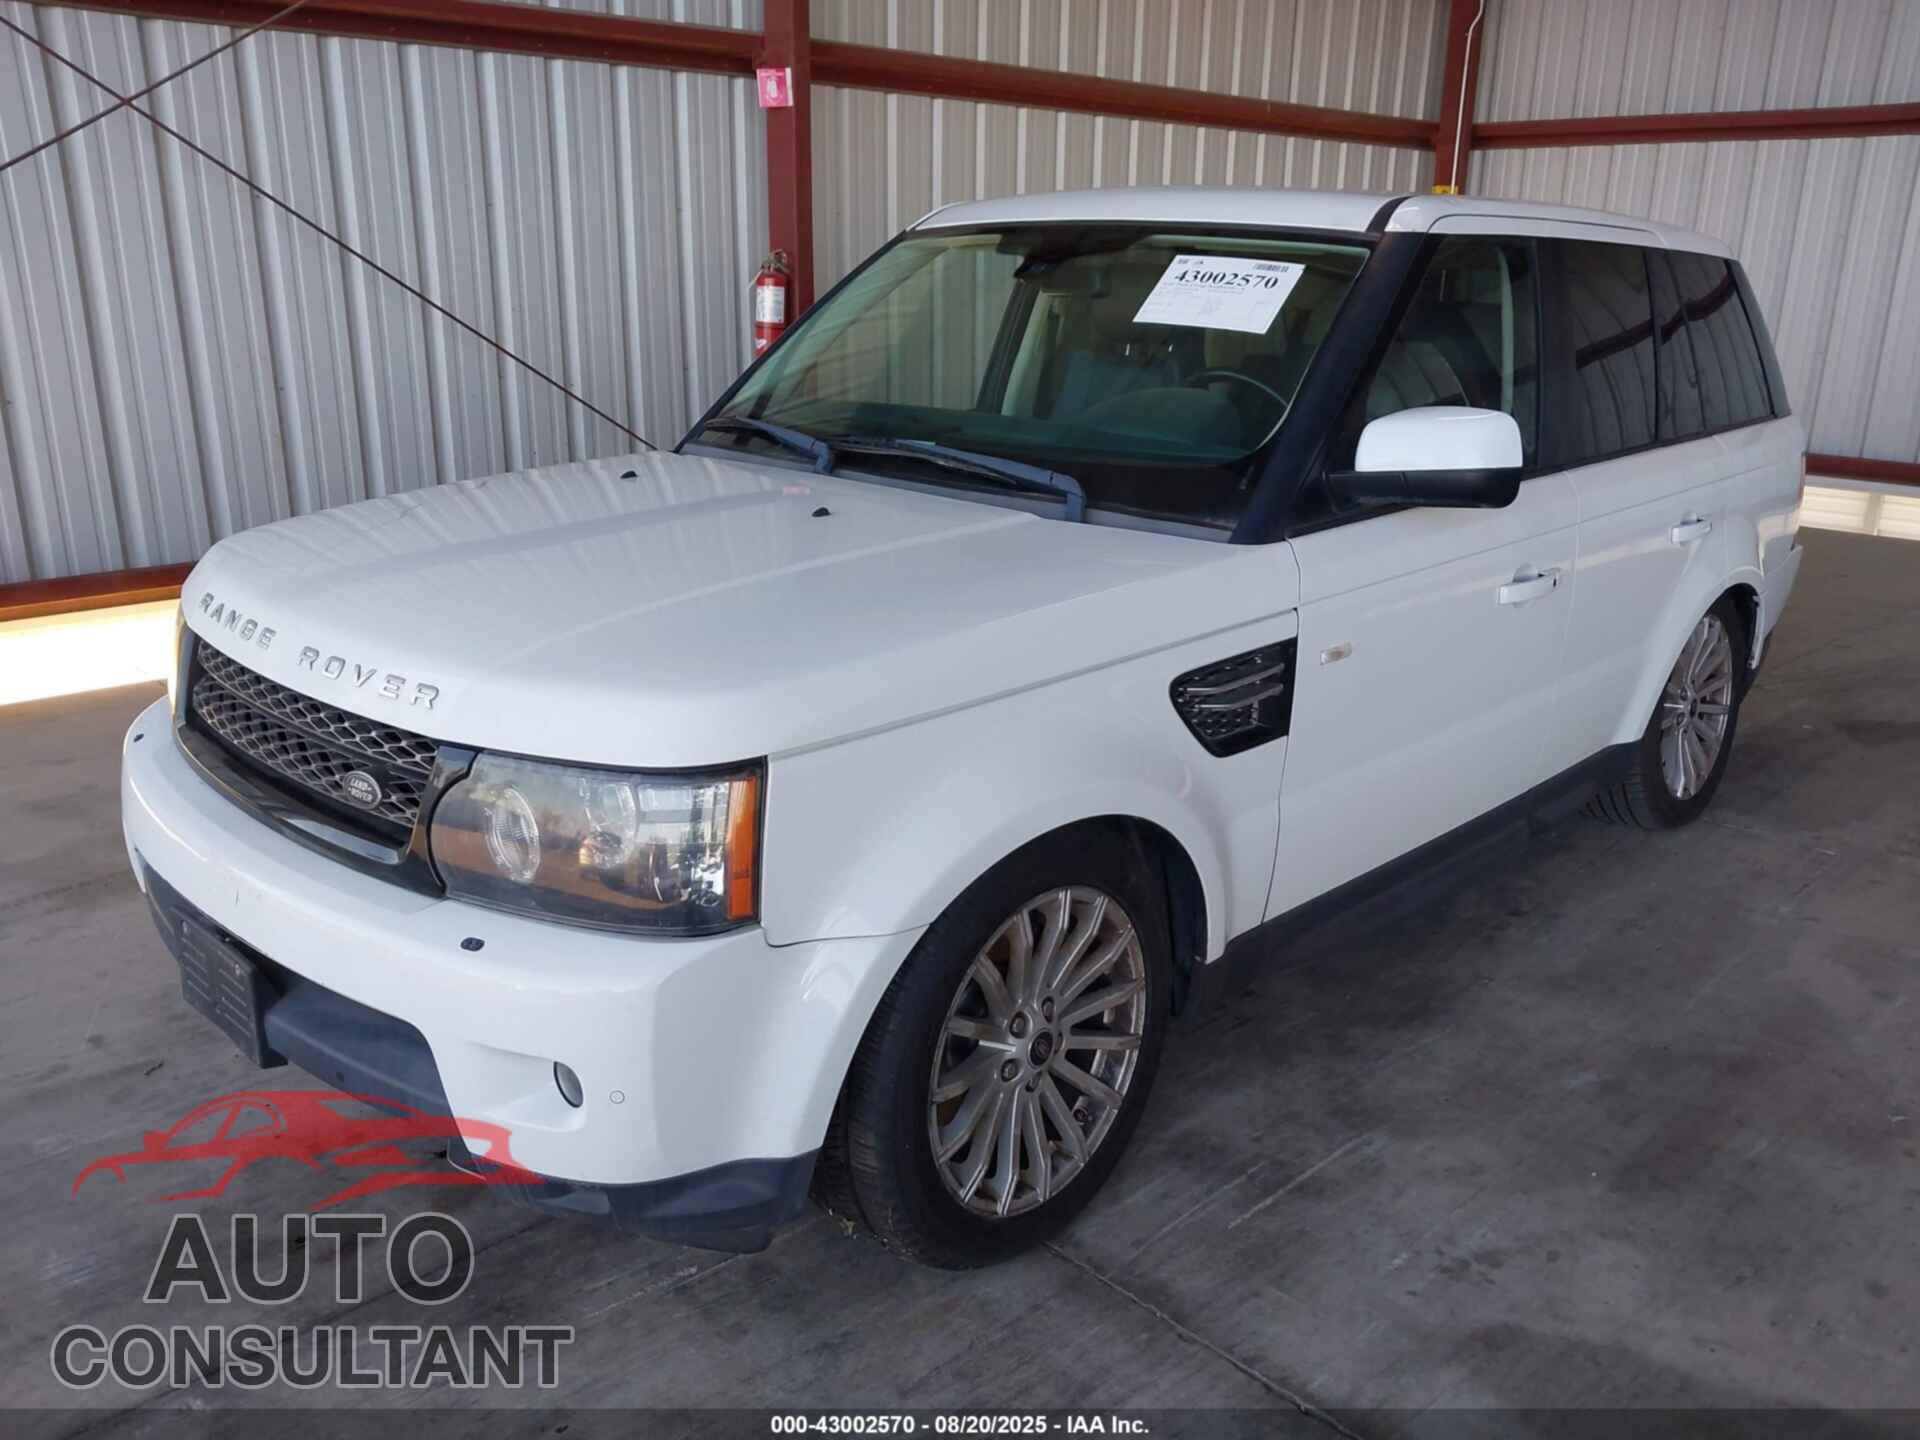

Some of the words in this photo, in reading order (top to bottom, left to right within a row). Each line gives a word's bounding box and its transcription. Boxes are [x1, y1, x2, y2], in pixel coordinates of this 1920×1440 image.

[1174, 269, 1279, 289] 43002570
[199, 592, 277, 650] RANGE
[297, 645, 441, 710] ROVER
